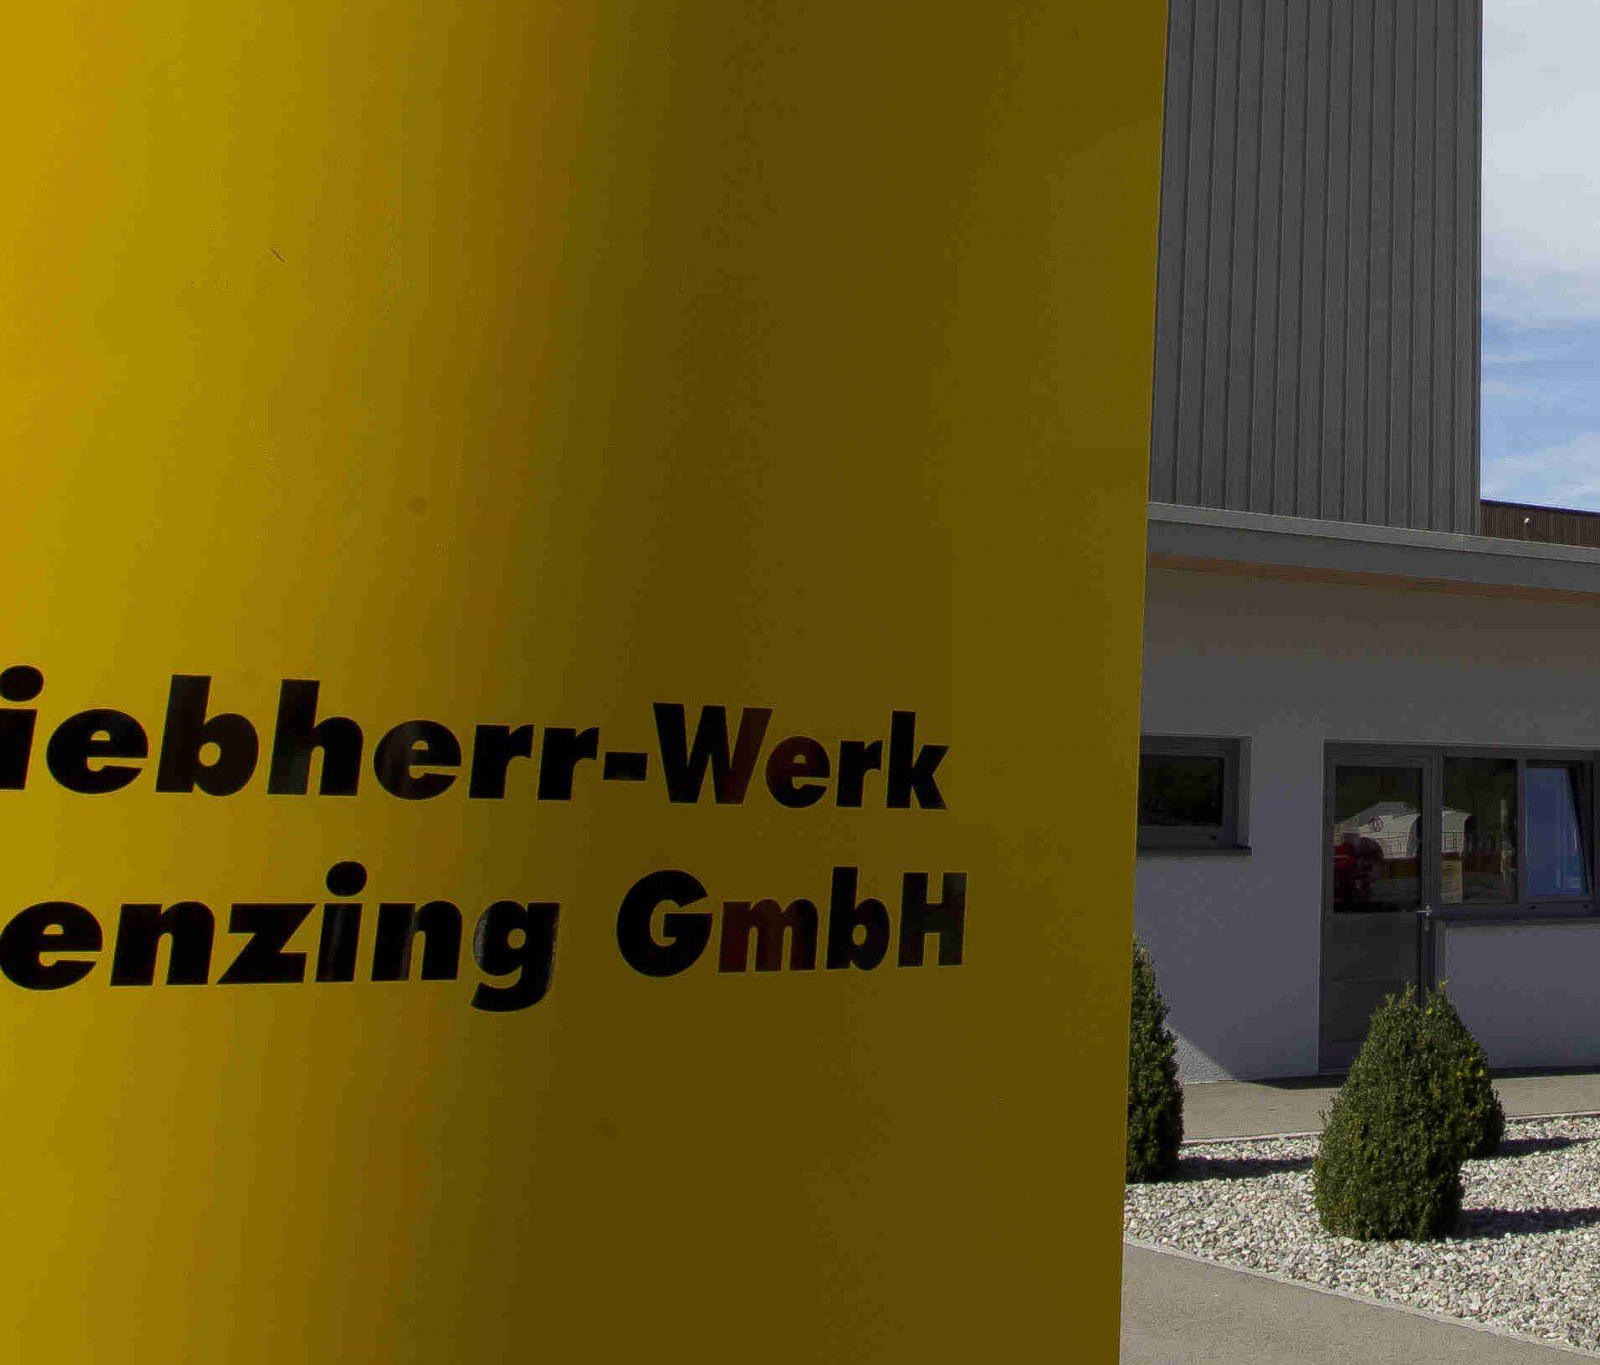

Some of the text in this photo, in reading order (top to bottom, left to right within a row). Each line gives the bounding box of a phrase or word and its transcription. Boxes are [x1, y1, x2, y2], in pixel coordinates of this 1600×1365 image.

[0, 664, 949, 810] iebherr-Werk
[0, 861, 968, 1012] enzing GmbH
